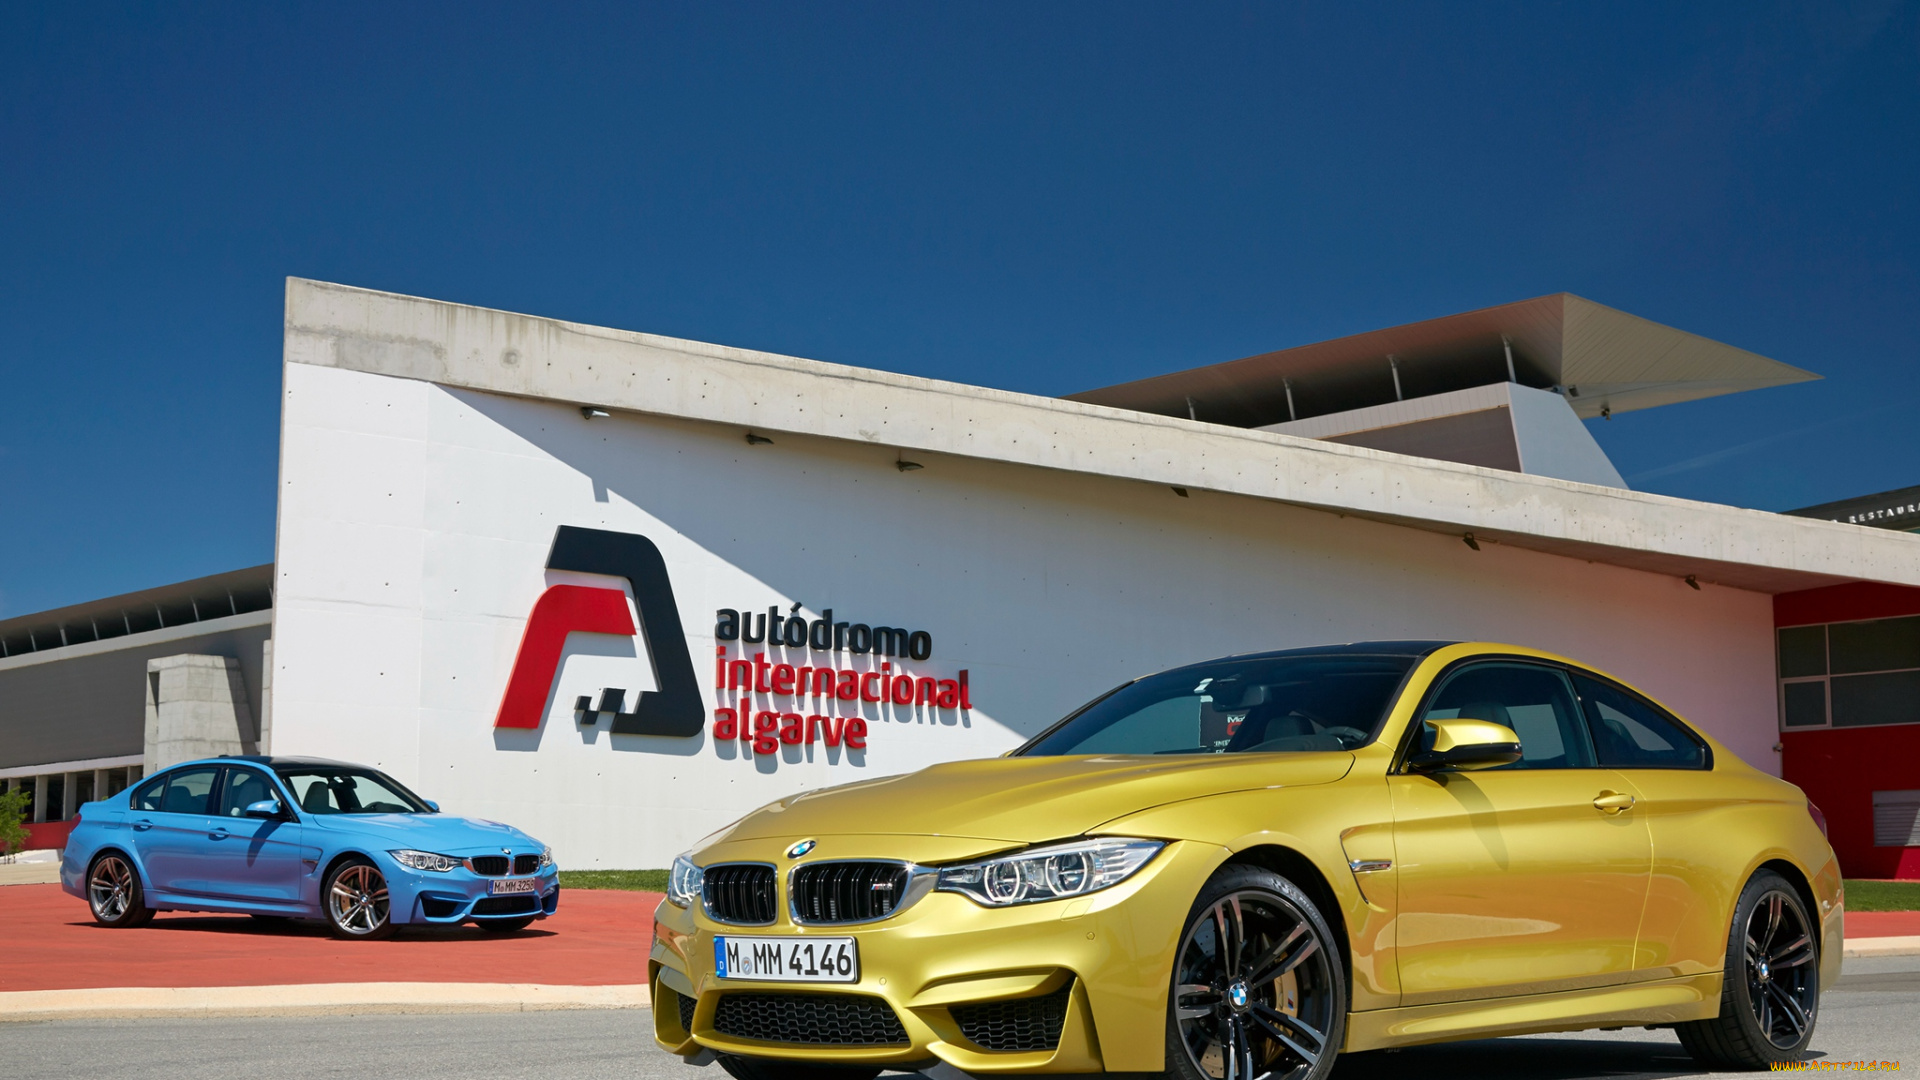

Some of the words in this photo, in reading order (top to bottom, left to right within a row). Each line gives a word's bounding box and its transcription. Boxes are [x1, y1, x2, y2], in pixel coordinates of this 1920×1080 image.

[715, 602, 932, 660] autódromo
[716, 645, 973, 709] internacional
[713, 698, 867, 754] algarve
[719, 961, 724, 970] D
[727, 942, 740, 973] M
[753, 943, 783, 975] MM
[789, 944, 852, 976] 4146
